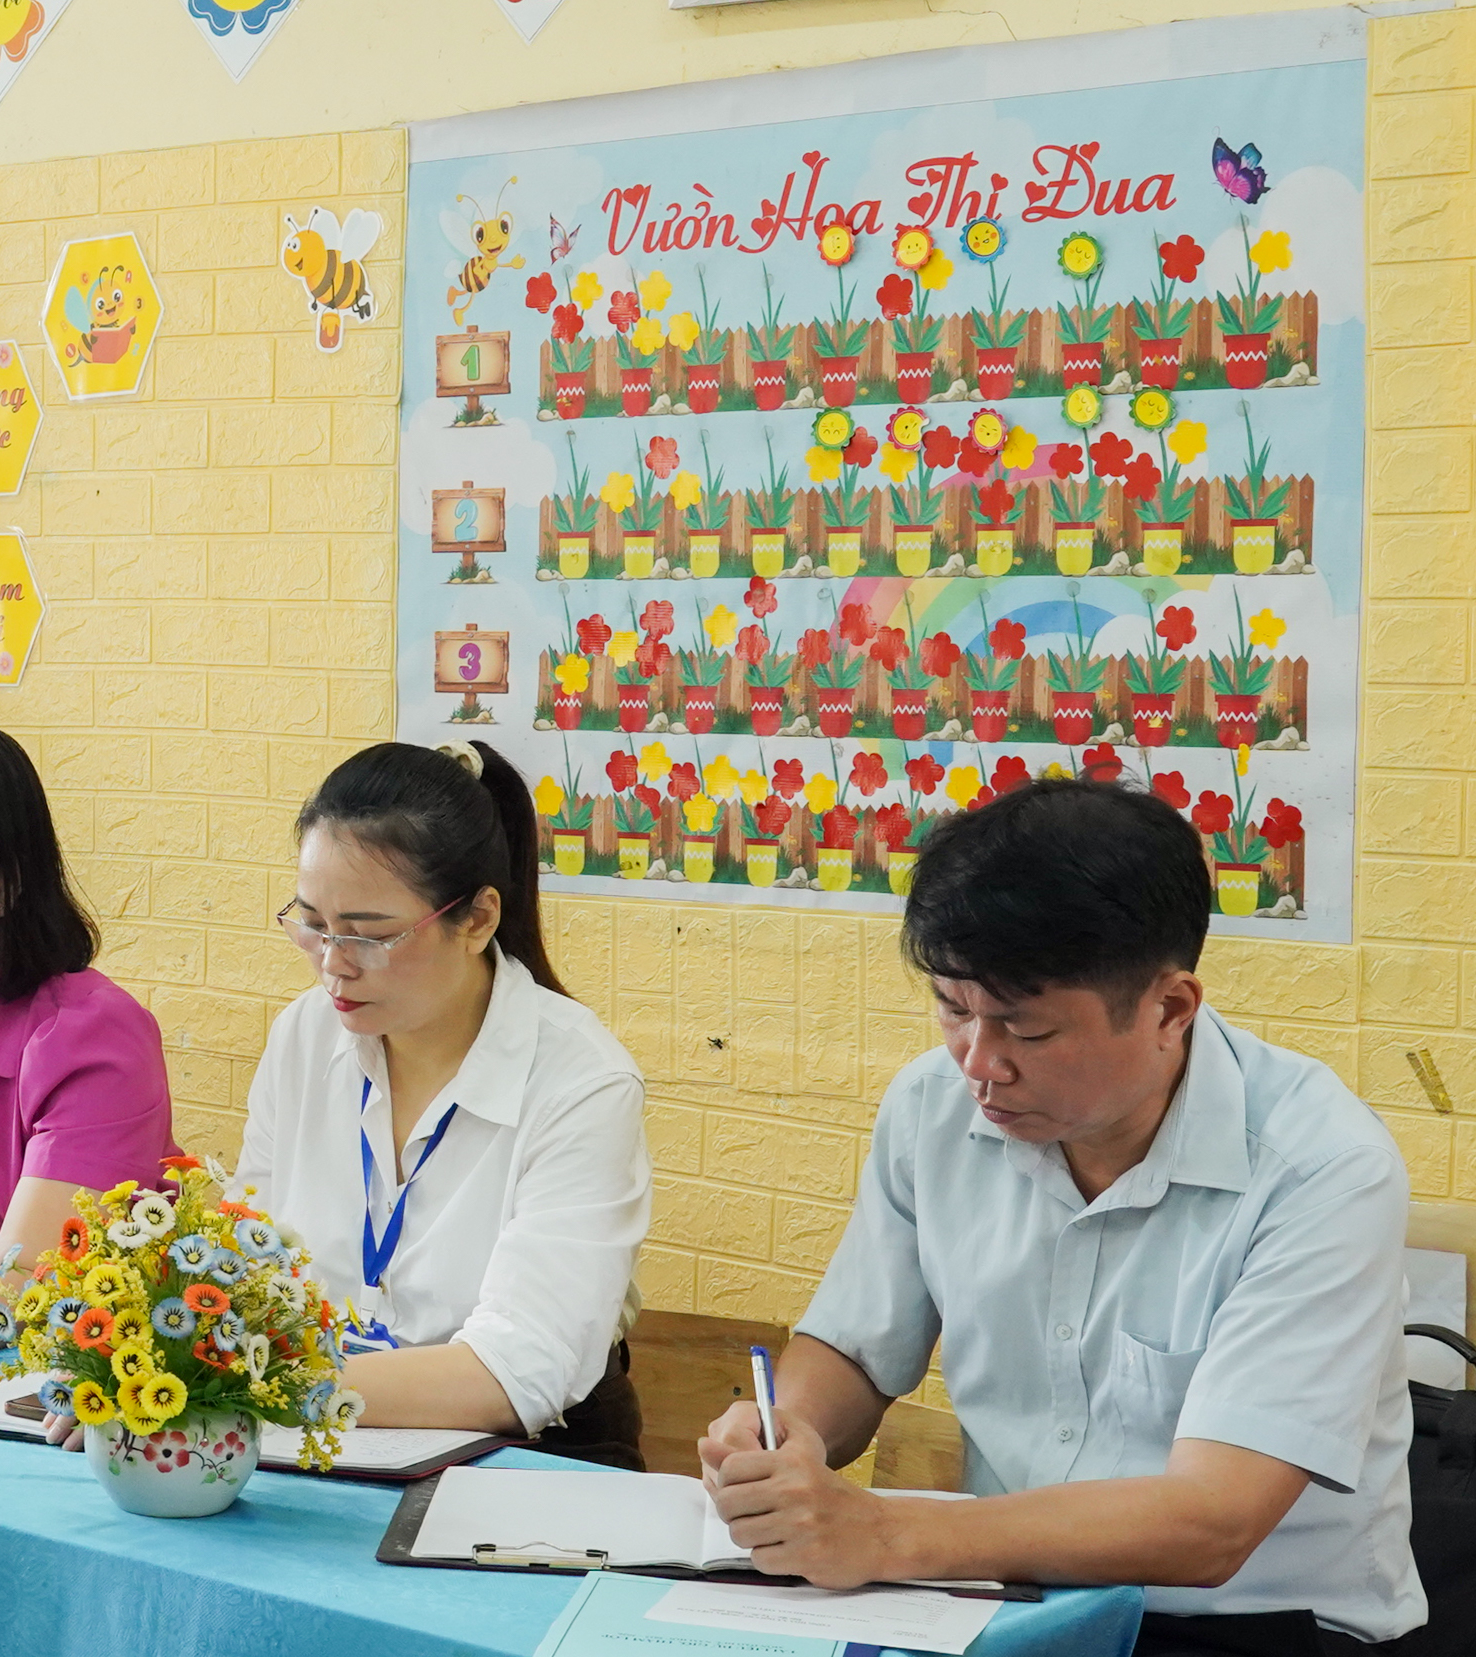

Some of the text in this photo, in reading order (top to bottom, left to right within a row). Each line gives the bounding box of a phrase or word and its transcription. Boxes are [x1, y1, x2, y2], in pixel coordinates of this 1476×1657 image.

[601, 141, 1177, 256] Vườn Hoa Thi Đua
[459, 344, 481, 381] 1
[454, 498, 478, 541] 2
[458, 643, 482, 681] 3
